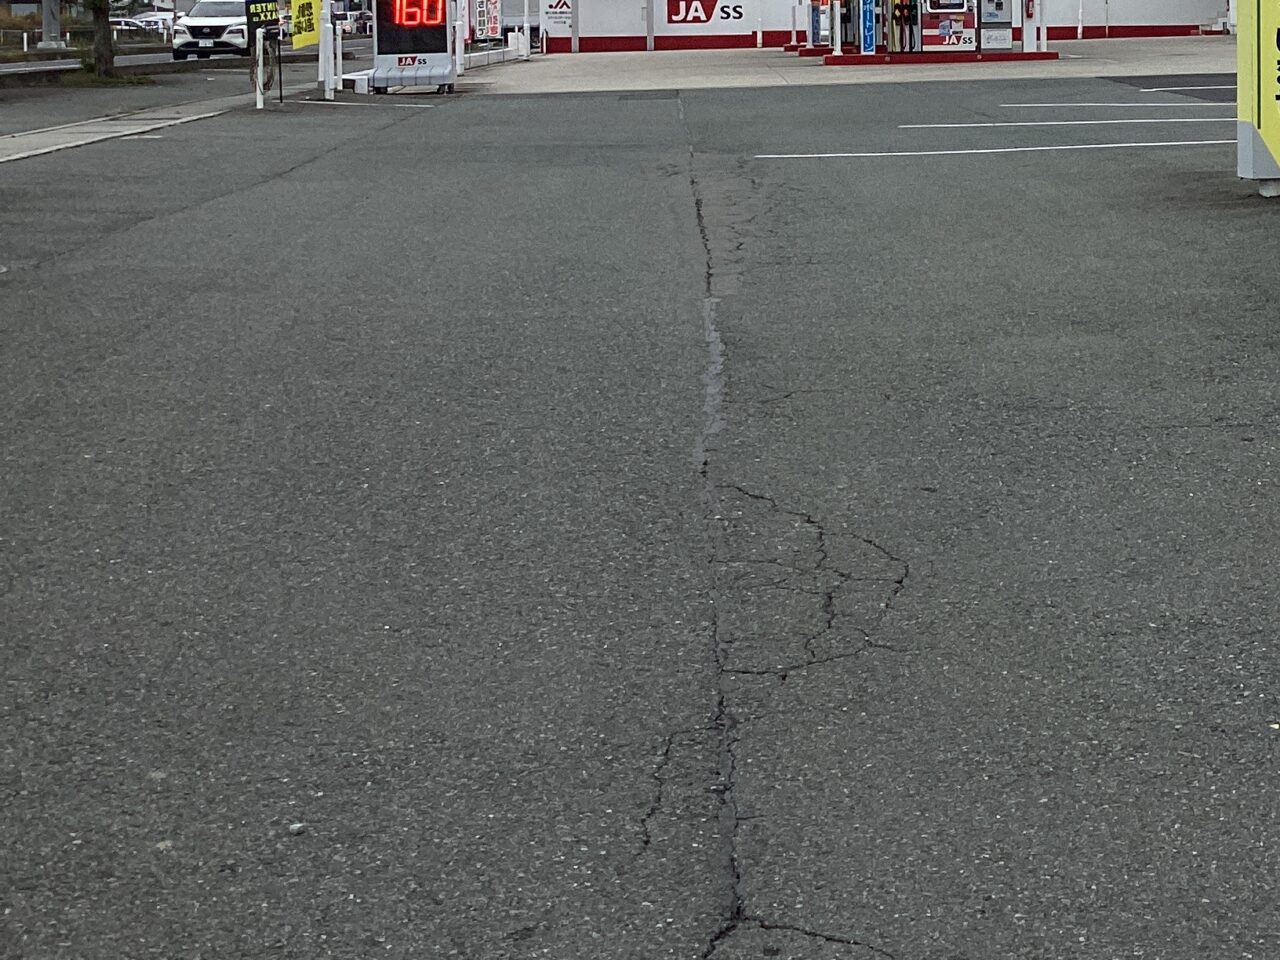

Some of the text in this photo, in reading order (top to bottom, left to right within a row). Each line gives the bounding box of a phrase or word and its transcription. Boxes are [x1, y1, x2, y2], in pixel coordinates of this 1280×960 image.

[672, 0, 707, 21] JA
[943, 35, 958, 45] JA
[400, 57, 414, 65] JA
